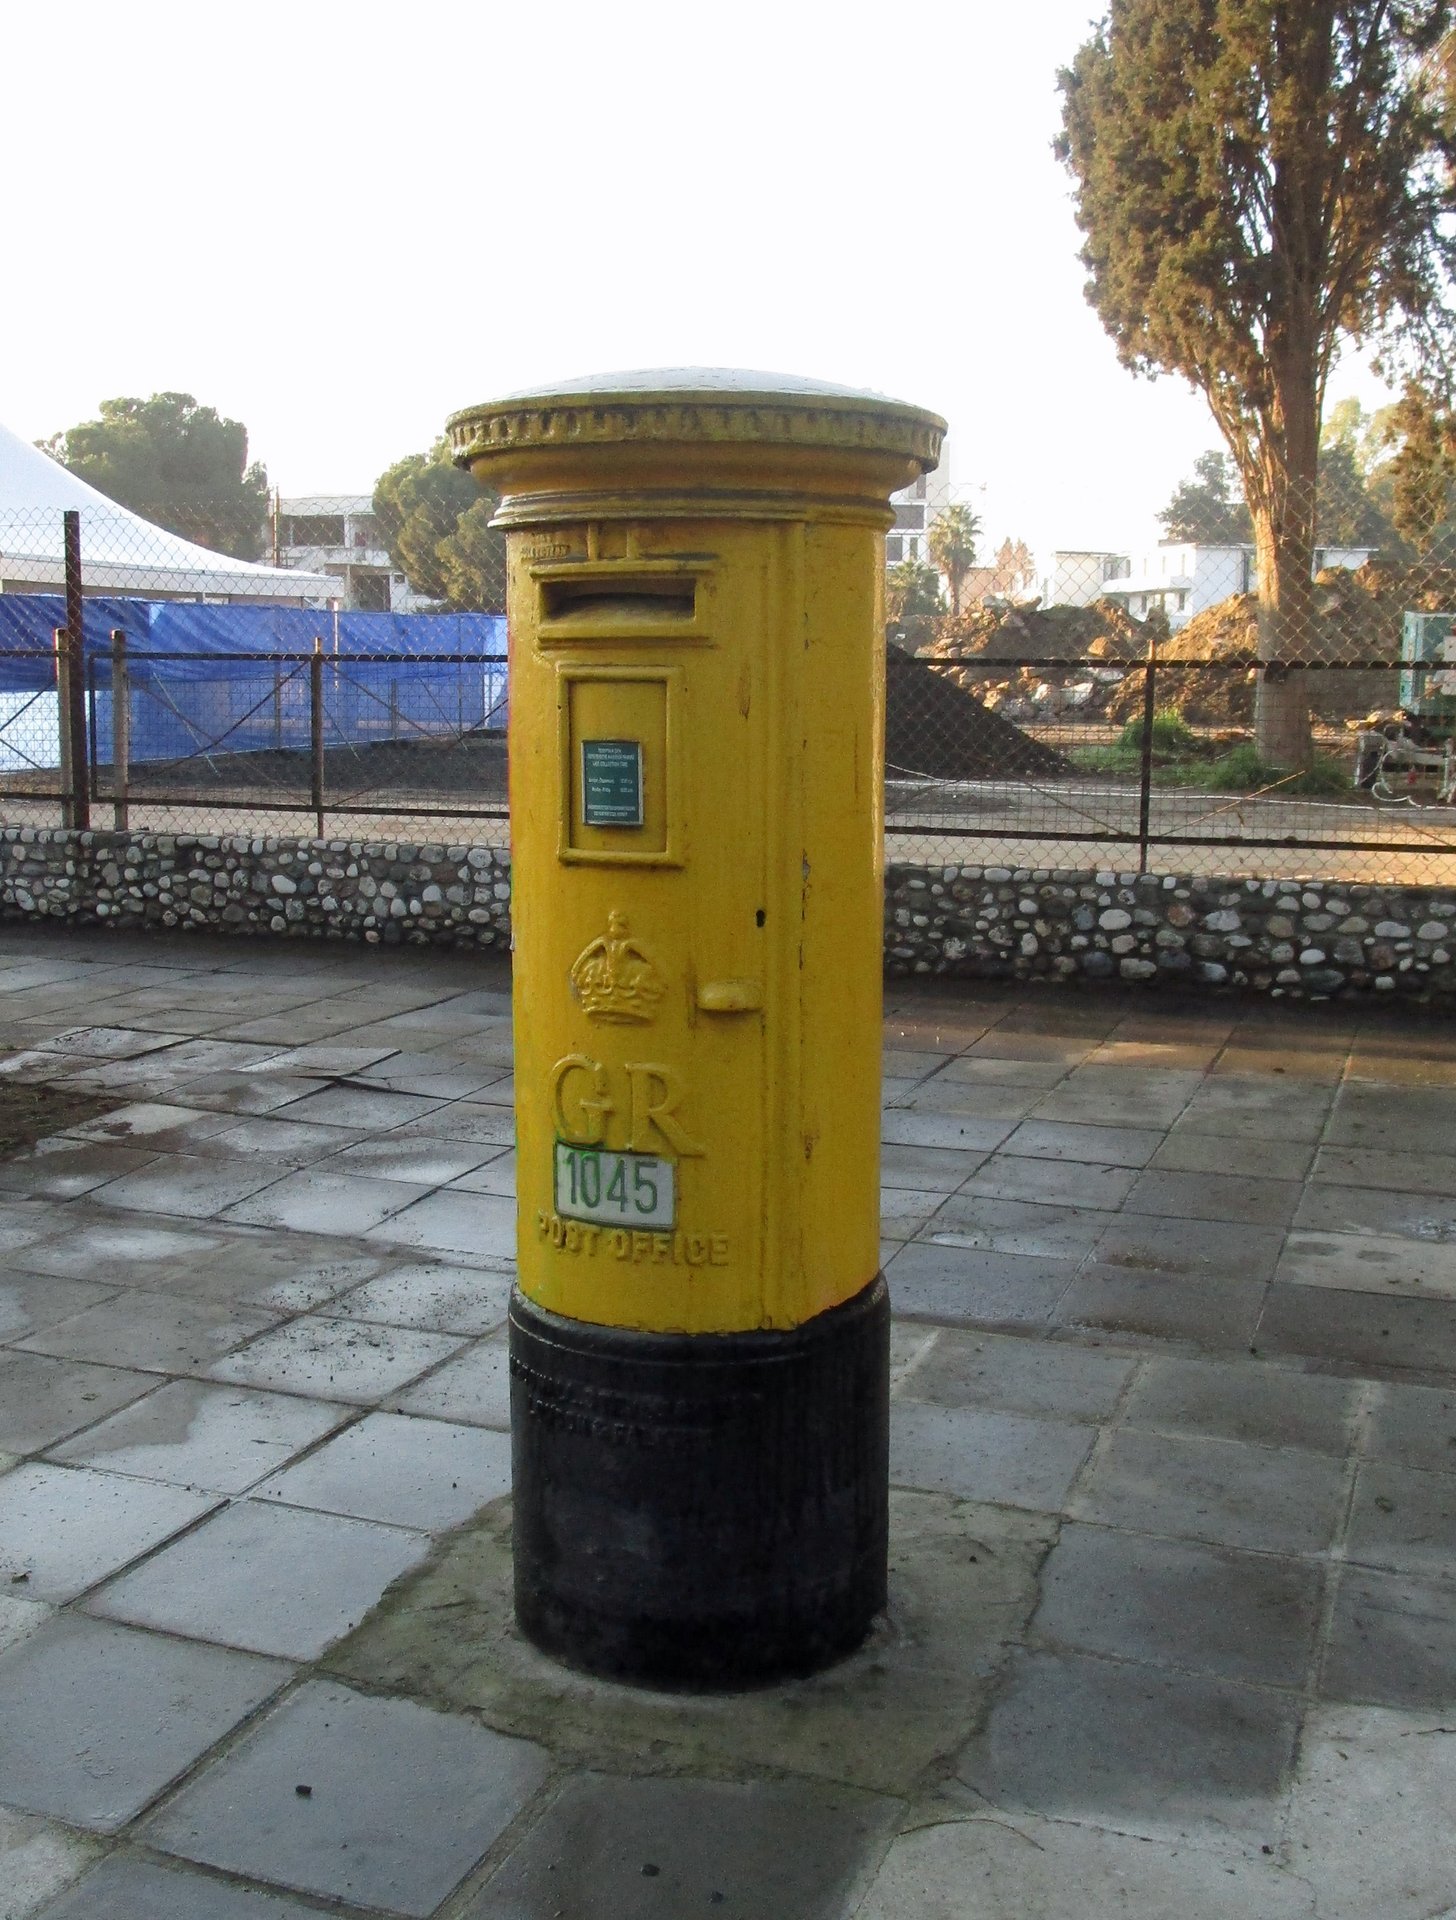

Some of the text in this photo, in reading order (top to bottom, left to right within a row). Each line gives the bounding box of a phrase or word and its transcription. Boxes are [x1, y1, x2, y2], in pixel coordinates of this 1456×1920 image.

[550, 1053, 704, 1158] GR
[563, 1151, 659, 1215] 1045
[537, 1209, 729, 1266] POST OFFICE
